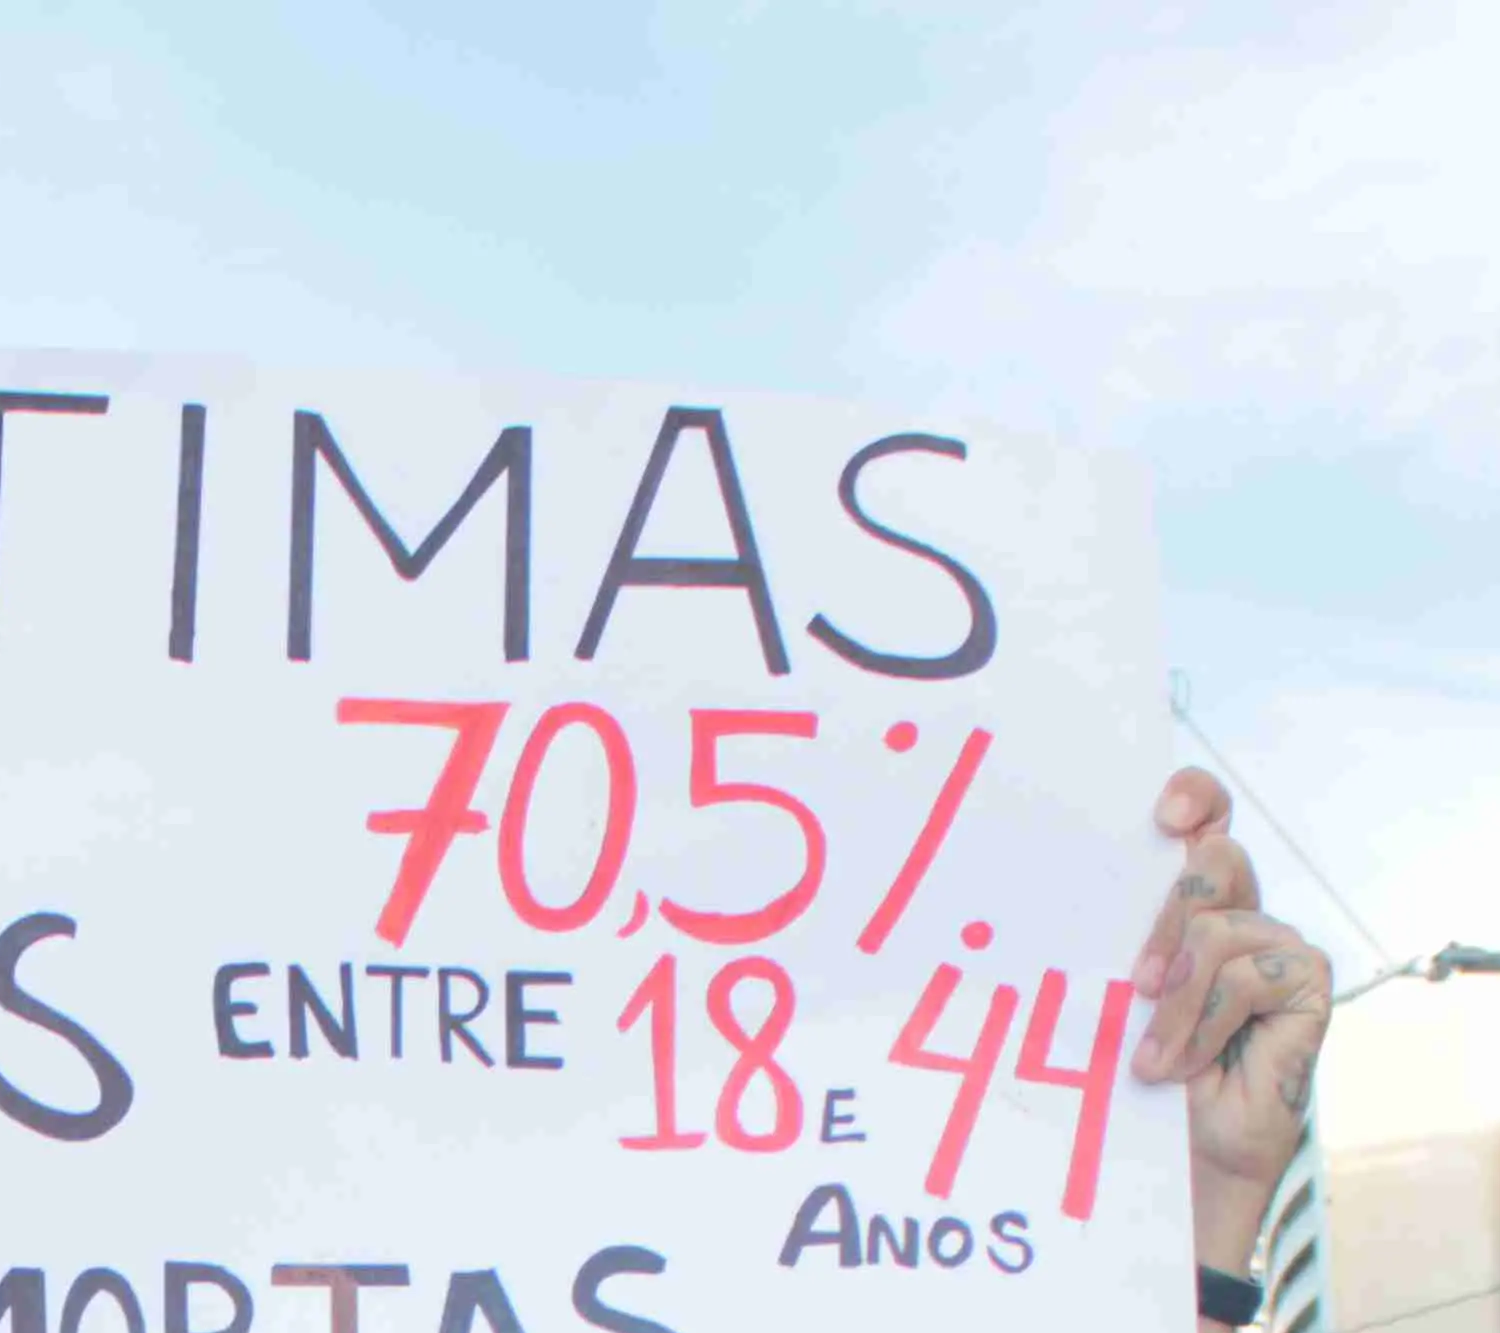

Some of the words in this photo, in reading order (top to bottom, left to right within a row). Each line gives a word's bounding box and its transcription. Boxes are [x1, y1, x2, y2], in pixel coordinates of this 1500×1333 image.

[335, 696, 994, 956] 70,5%
[211, 959, 575, 1071] ENTRE
[615, 952, 804, 1153] 18
[819, 1086, 867, 1144] E
[887, 958, 1146, 1222] 44
